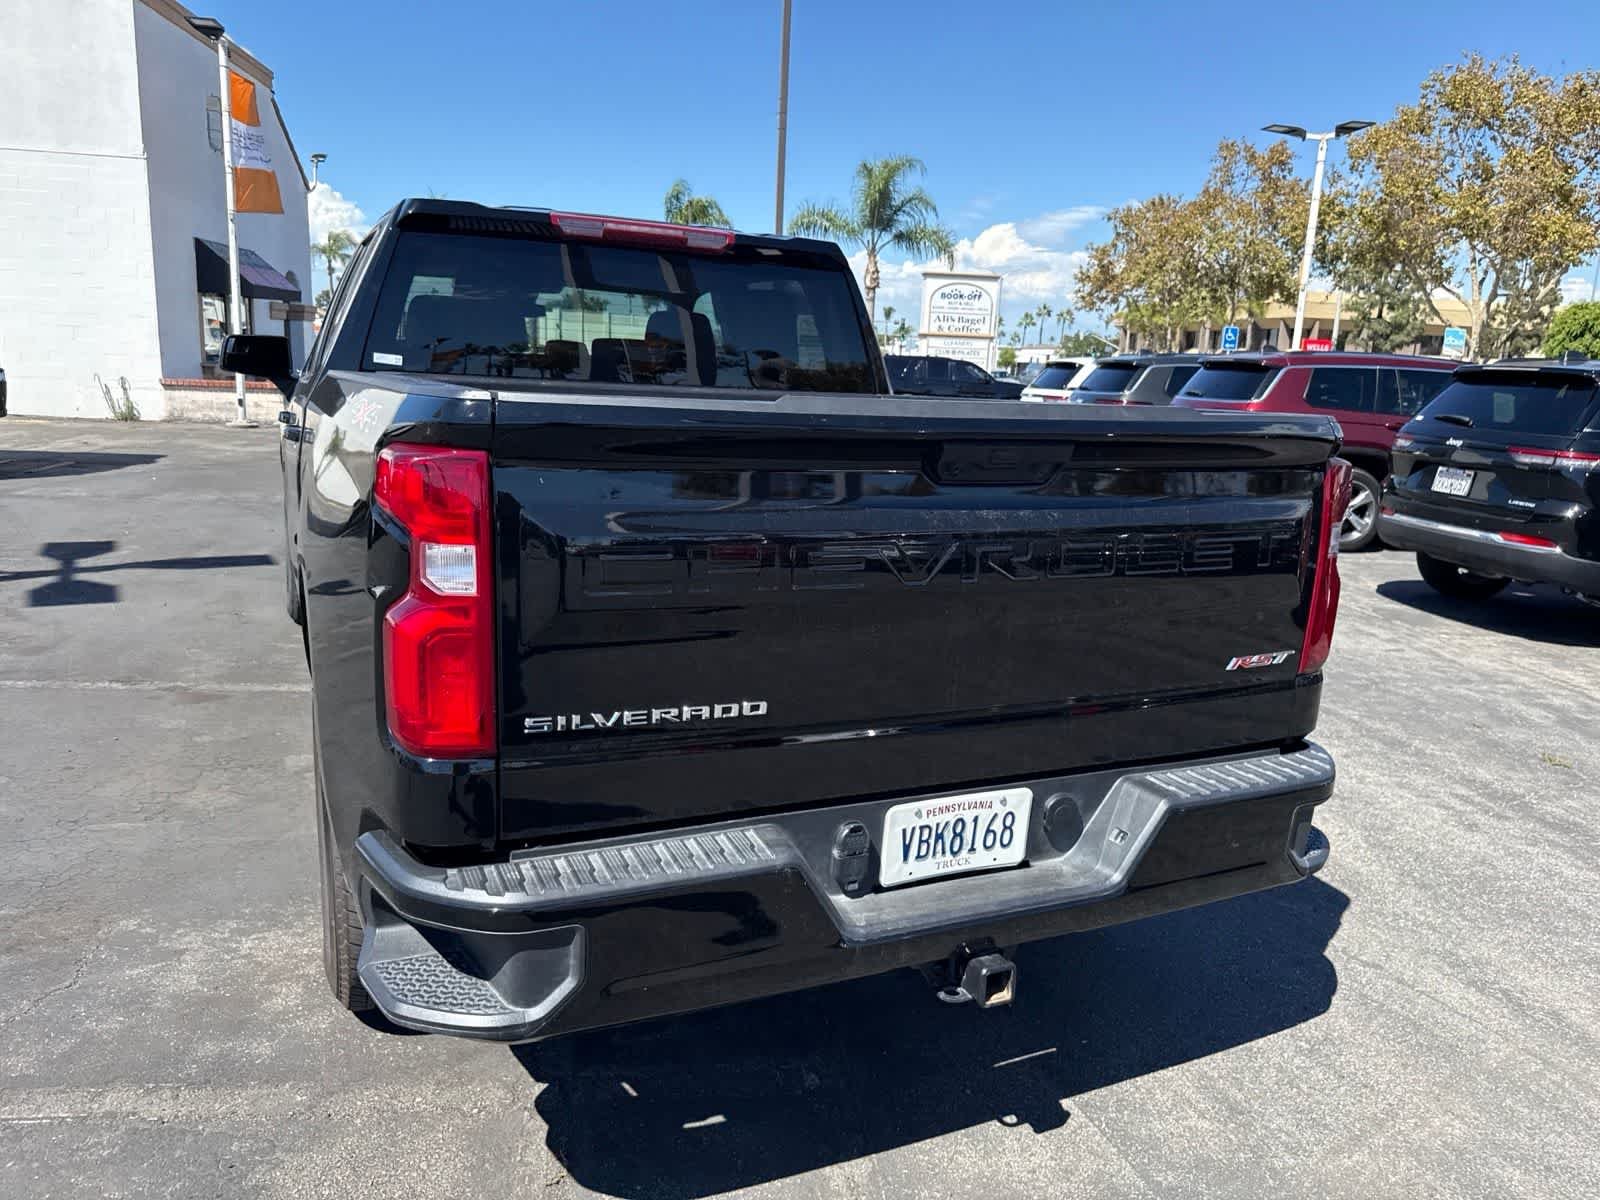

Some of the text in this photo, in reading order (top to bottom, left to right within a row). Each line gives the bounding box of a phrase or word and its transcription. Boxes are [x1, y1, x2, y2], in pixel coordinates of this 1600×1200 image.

[937, 325, 982, 334] & Coffee
[957, 315, 986, 326] Bagel
[583, 526, 1293, 598] CHEVROLET
[1225, 650, 1296, 671] RST
[523, 700, 768, 734] SILVERADO
[926, 800, 993, 818] PENNSYLVANIA
[902, 811, 1016, 864] VBK8168
[935, 856, 971, 870] TRUCK
